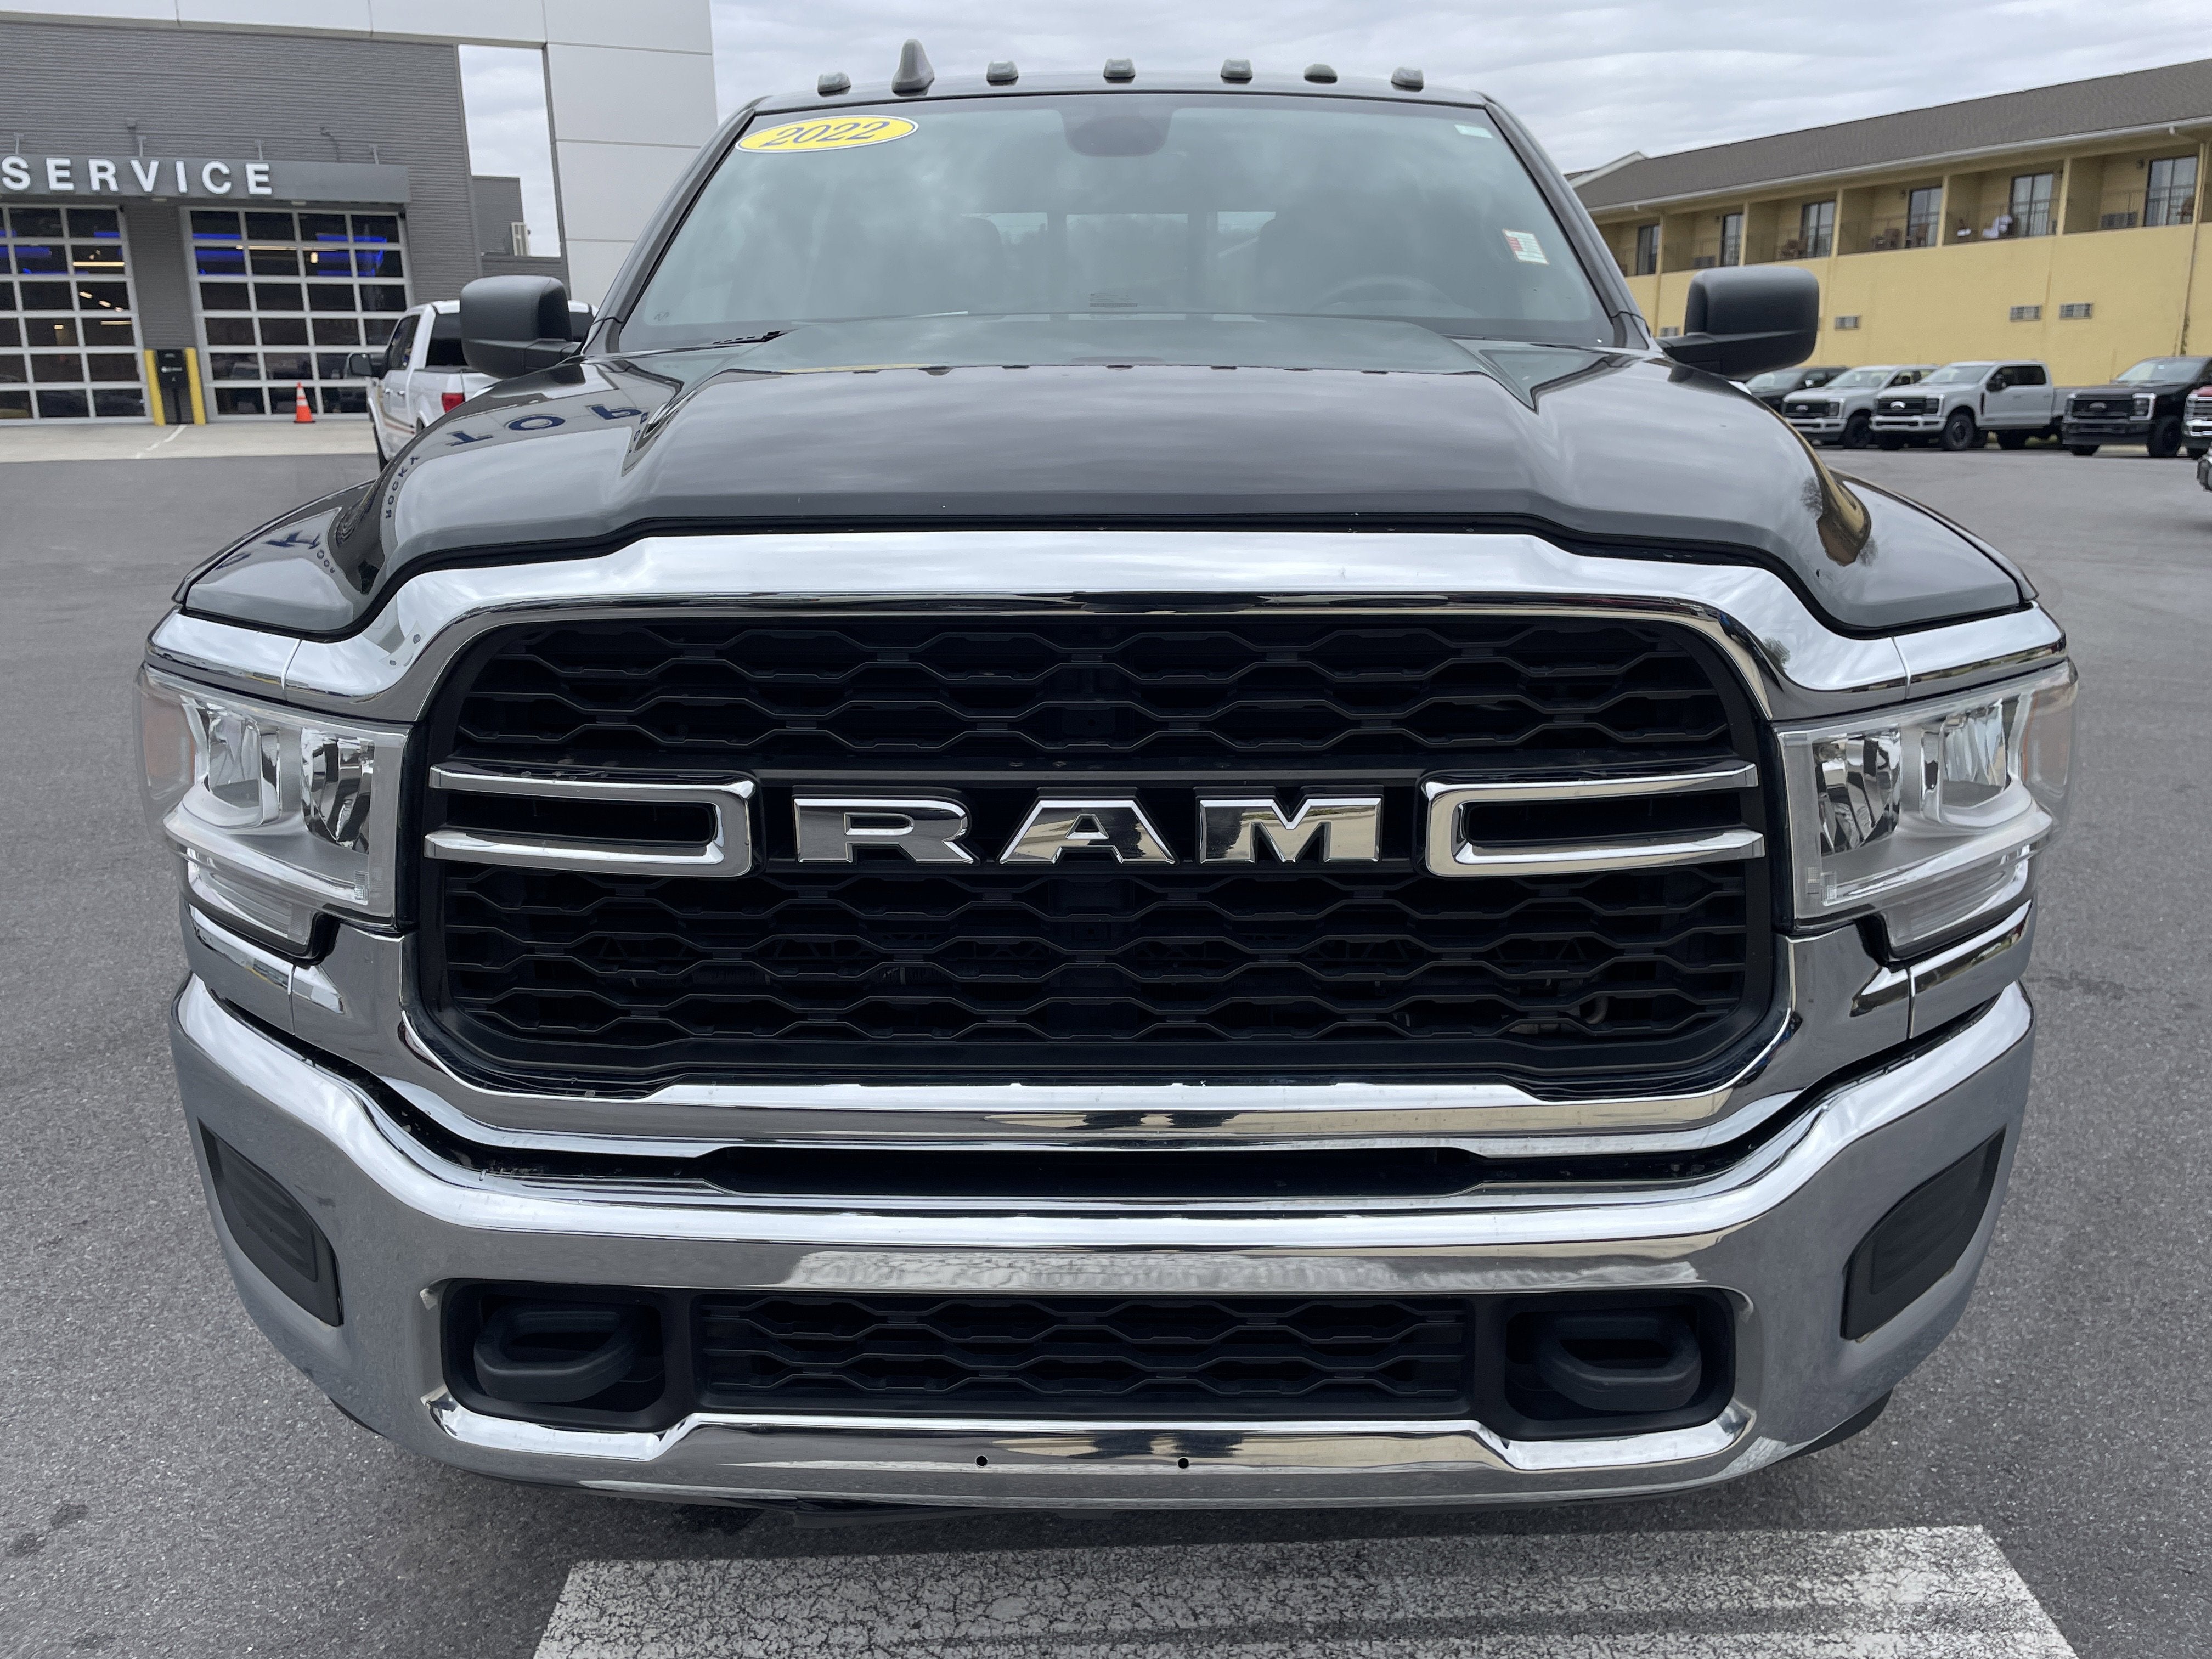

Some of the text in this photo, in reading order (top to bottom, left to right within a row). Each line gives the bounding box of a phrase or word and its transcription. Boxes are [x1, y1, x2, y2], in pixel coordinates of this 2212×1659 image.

[759, 120, 890, 148] 2022
[2, 156, 273, 195] SERVICE
[793, 797, 1381, 865] RAM
